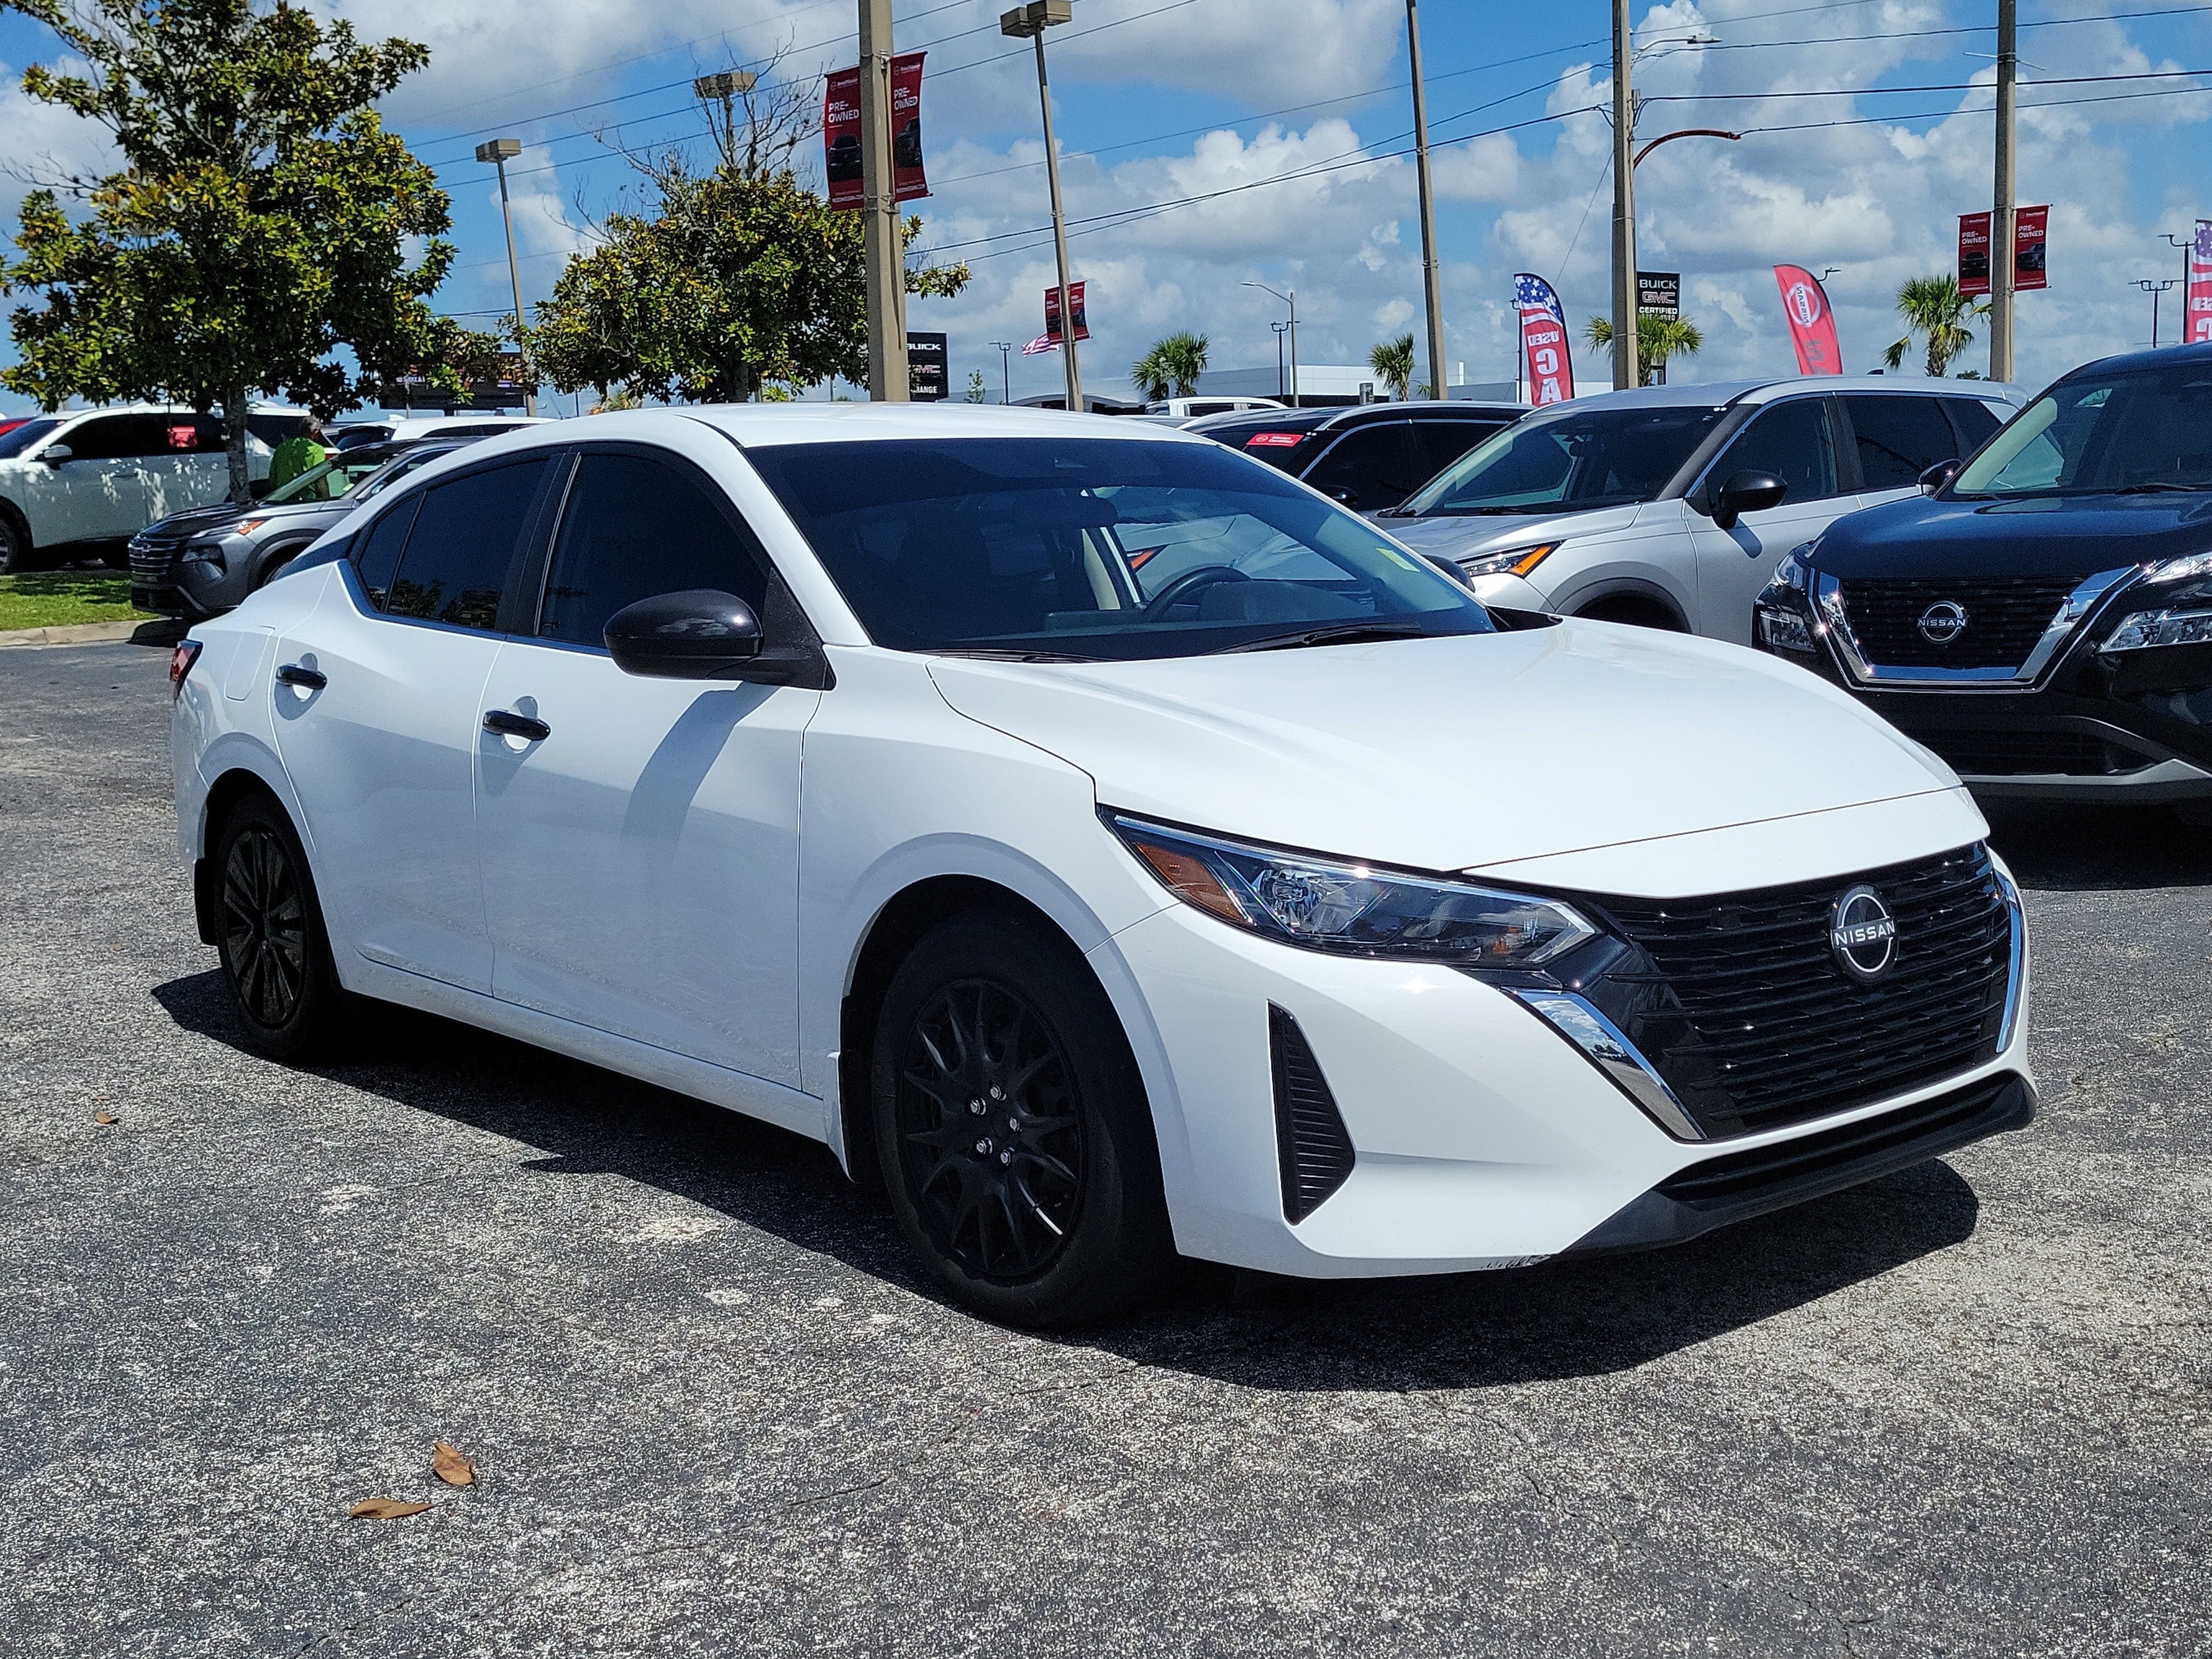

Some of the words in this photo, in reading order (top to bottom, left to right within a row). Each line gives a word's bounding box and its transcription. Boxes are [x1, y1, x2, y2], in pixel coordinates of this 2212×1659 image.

[894, 87, 911, 99] PRE-
[828, 101, 849, 113] PRE-
[894, 95, 918, 110] OWNED
[828, 109, 860, 123] OWNED
[1961, 236, 1987, 245] OWNED
[2018, 230, 2044, 239] OWNED
[1639, 279, 1677, 289] BUICK
[1642, 291, 1676, 304] GMC
[1639, 306, 1678, 314] CERTIFIED
[1834, 920, 1895, 945] NISSAN
